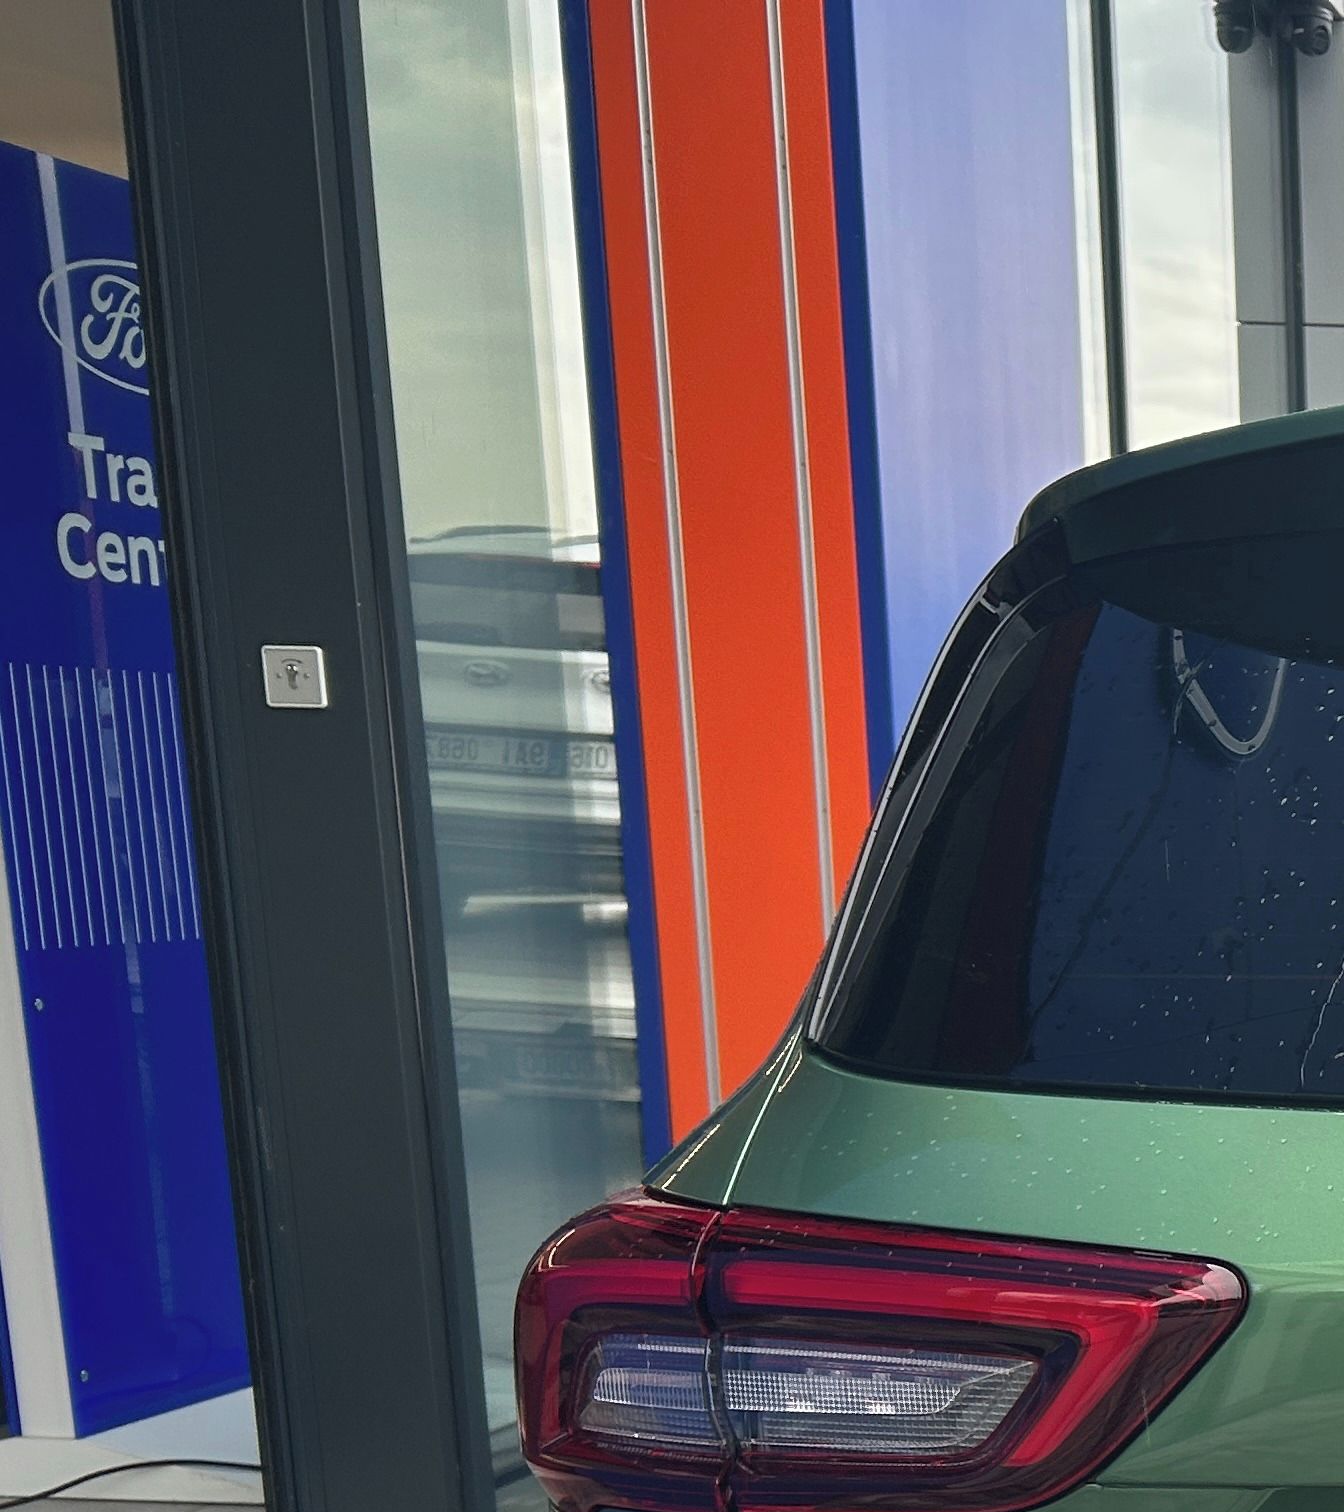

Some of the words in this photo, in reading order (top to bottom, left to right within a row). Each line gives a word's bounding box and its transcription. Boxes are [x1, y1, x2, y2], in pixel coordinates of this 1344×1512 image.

[81, 273, 148, 369] Fo
[67, 431, 159, 507] Tra
[56, 512, 168, 587] Cen
